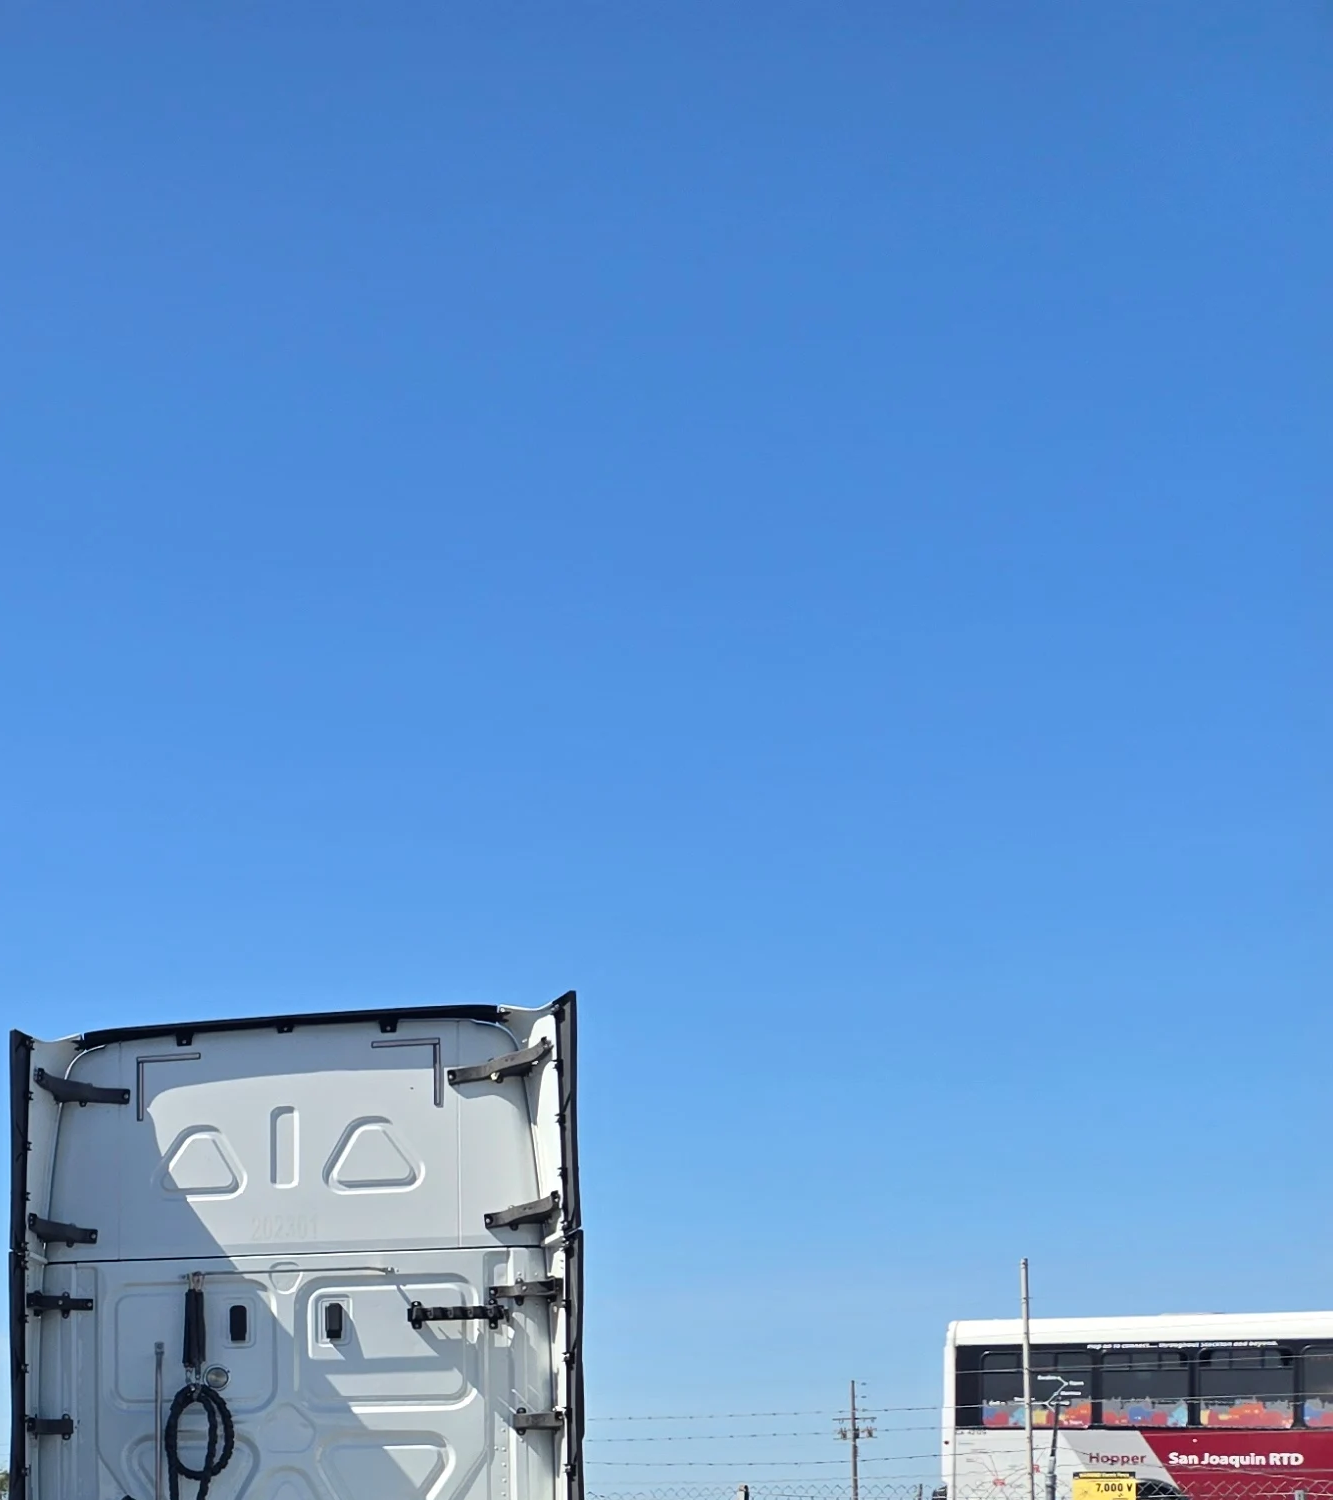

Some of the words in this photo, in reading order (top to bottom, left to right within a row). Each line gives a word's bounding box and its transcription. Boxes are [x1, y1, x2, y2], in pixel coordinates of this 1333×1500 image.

[1089, 1453, 1146, 1466] Hopper
[1169, 1452, 1202, 1465] San
[1201, 1453, 1267, 1468] Joaquin
[1269, 1452, 1305, 1466] RTD
[1095, 1483, 1123, 1493] 7,000
